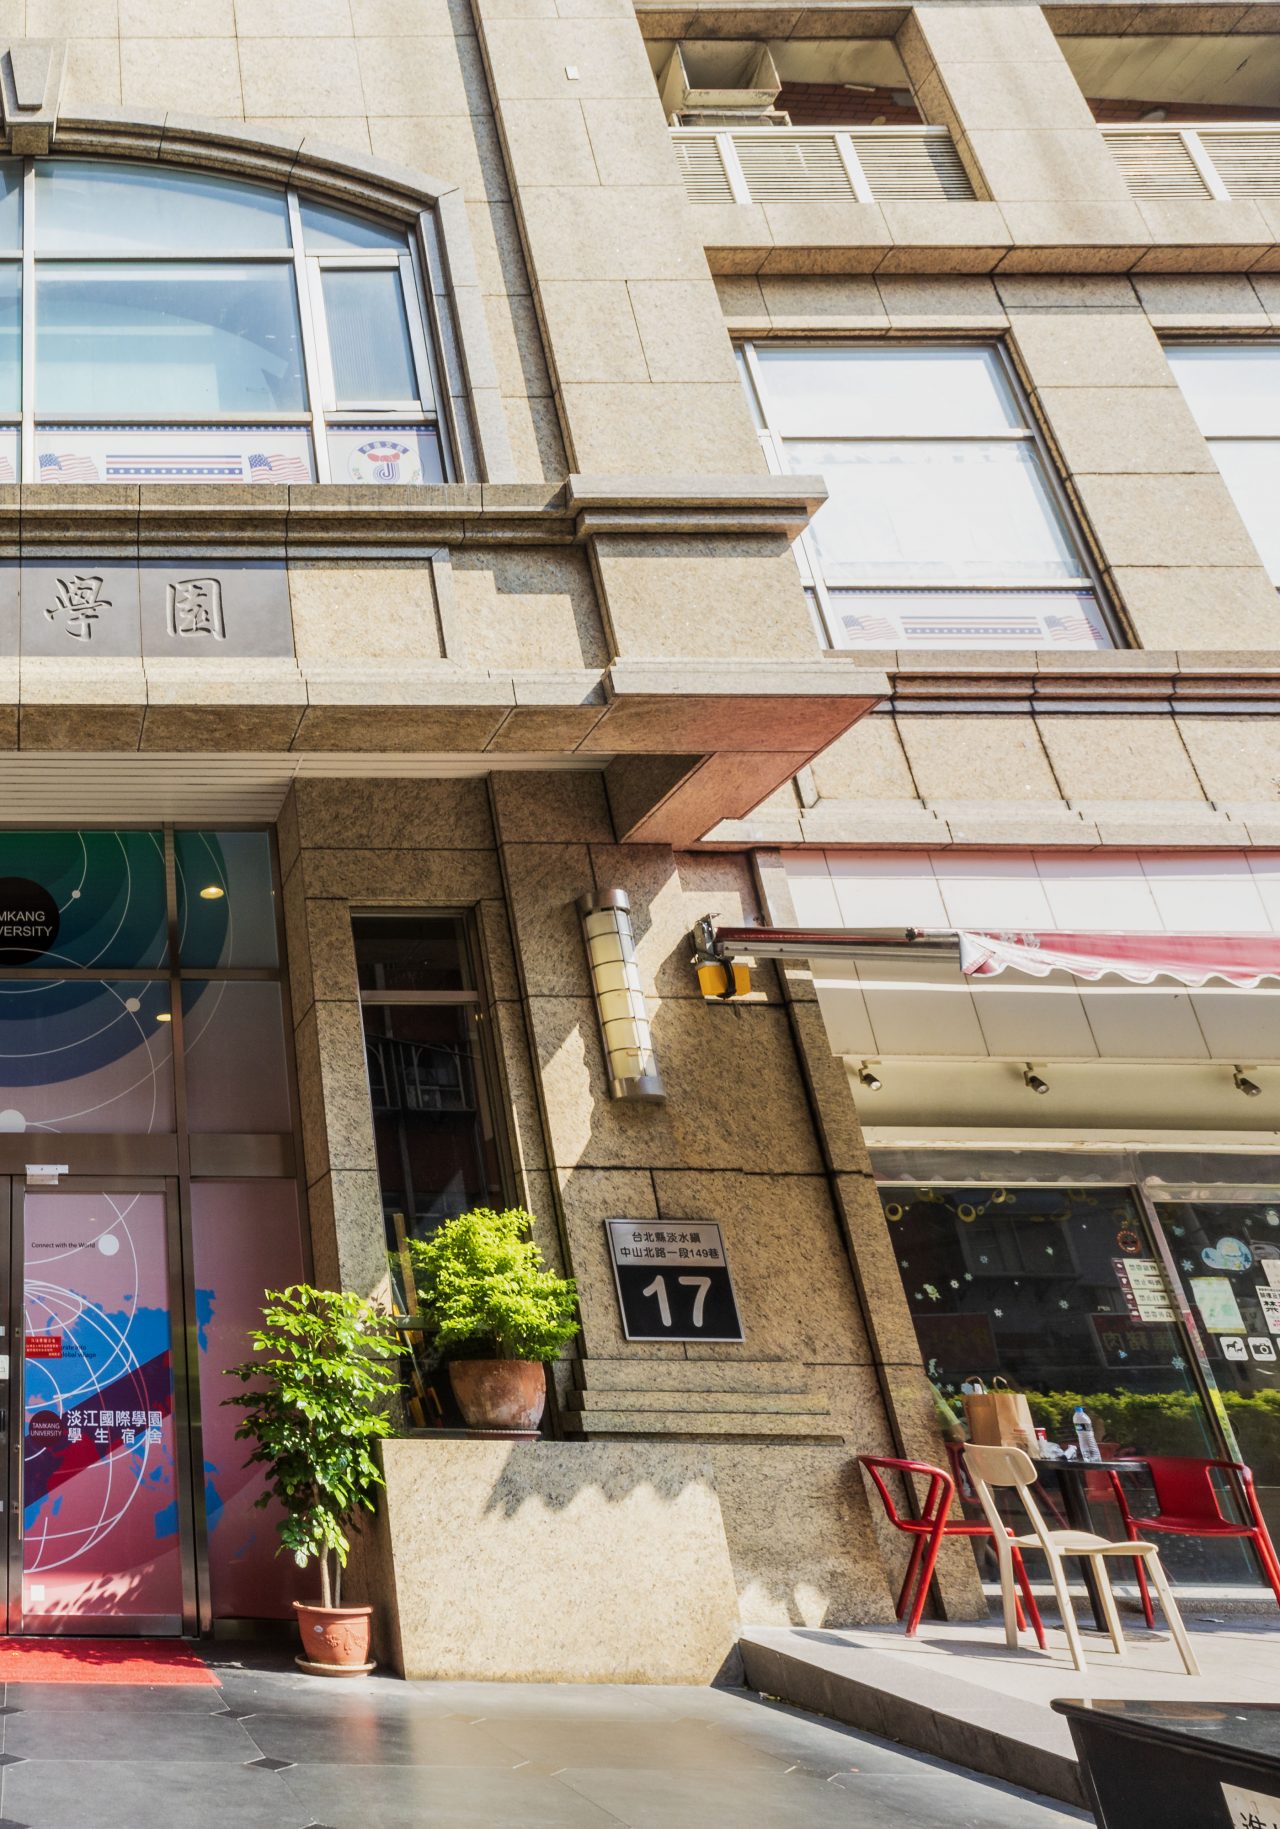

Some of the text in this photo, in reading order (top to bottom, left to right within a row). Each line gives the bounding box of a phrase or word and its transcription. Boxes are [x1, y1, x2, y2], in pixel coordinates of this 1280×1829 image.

[642, 1274, 712, 1328] 17
[67, 1410, 163, 1428] 淡江國際學園
